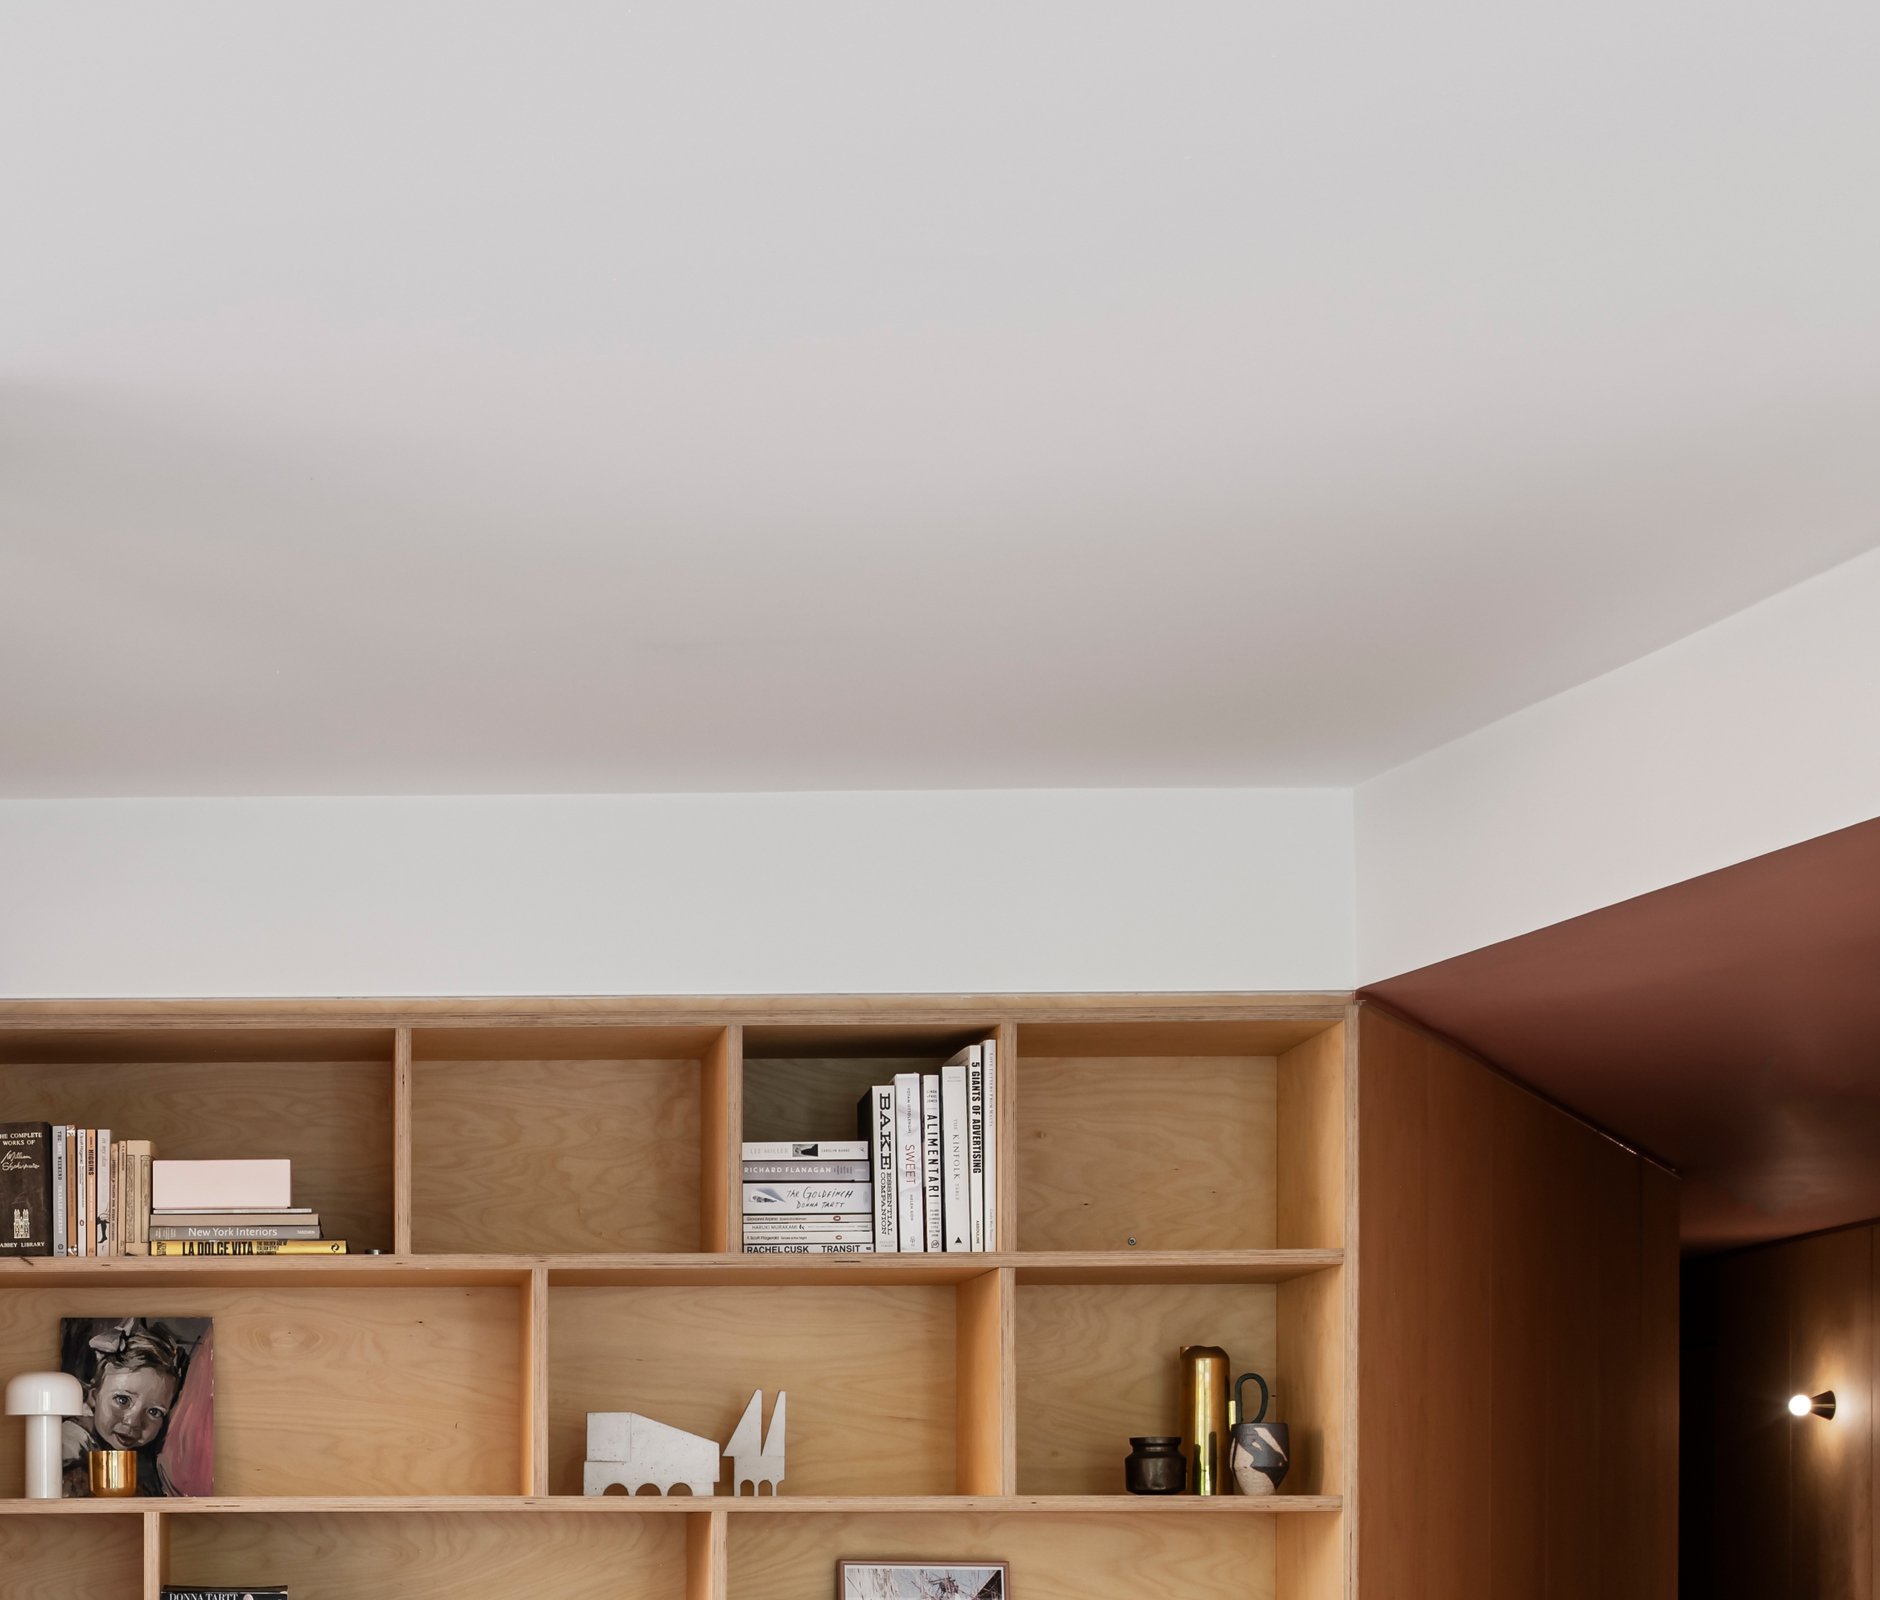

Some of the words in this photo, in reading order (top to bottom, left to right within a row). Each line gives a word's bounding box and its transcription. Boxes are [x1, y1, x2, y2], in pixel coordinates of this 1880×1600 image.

[972, 1071, 980, 1102] GIANTS
[972, 1105, 981, 1116] OF
[879, 1093, 892, 1170] BAKE
[972, 1119, 982, 1174] ADVERTISING
[905, 1145, 916, 1184] SWEET
[926, 1114, 939, 1198] ALIMENTARI
[952, 1134, 961, 1180] KINFOLK
[182, 1242, 196, 1256] LA
[198, 1242, 231, 1256] DOLCE
[232, 1242, 254, 1256] VITA
[188, 1228, 211, 1237] New
[213, 1228, 235, 1237] York
[236, 1228, 278, 1237] Interiors
[747, 1246, 782, 1254] RACHEL
[783, 1245, 809, 1253] CUSK
[821, 1245, 861, 1253] TRANSIT
